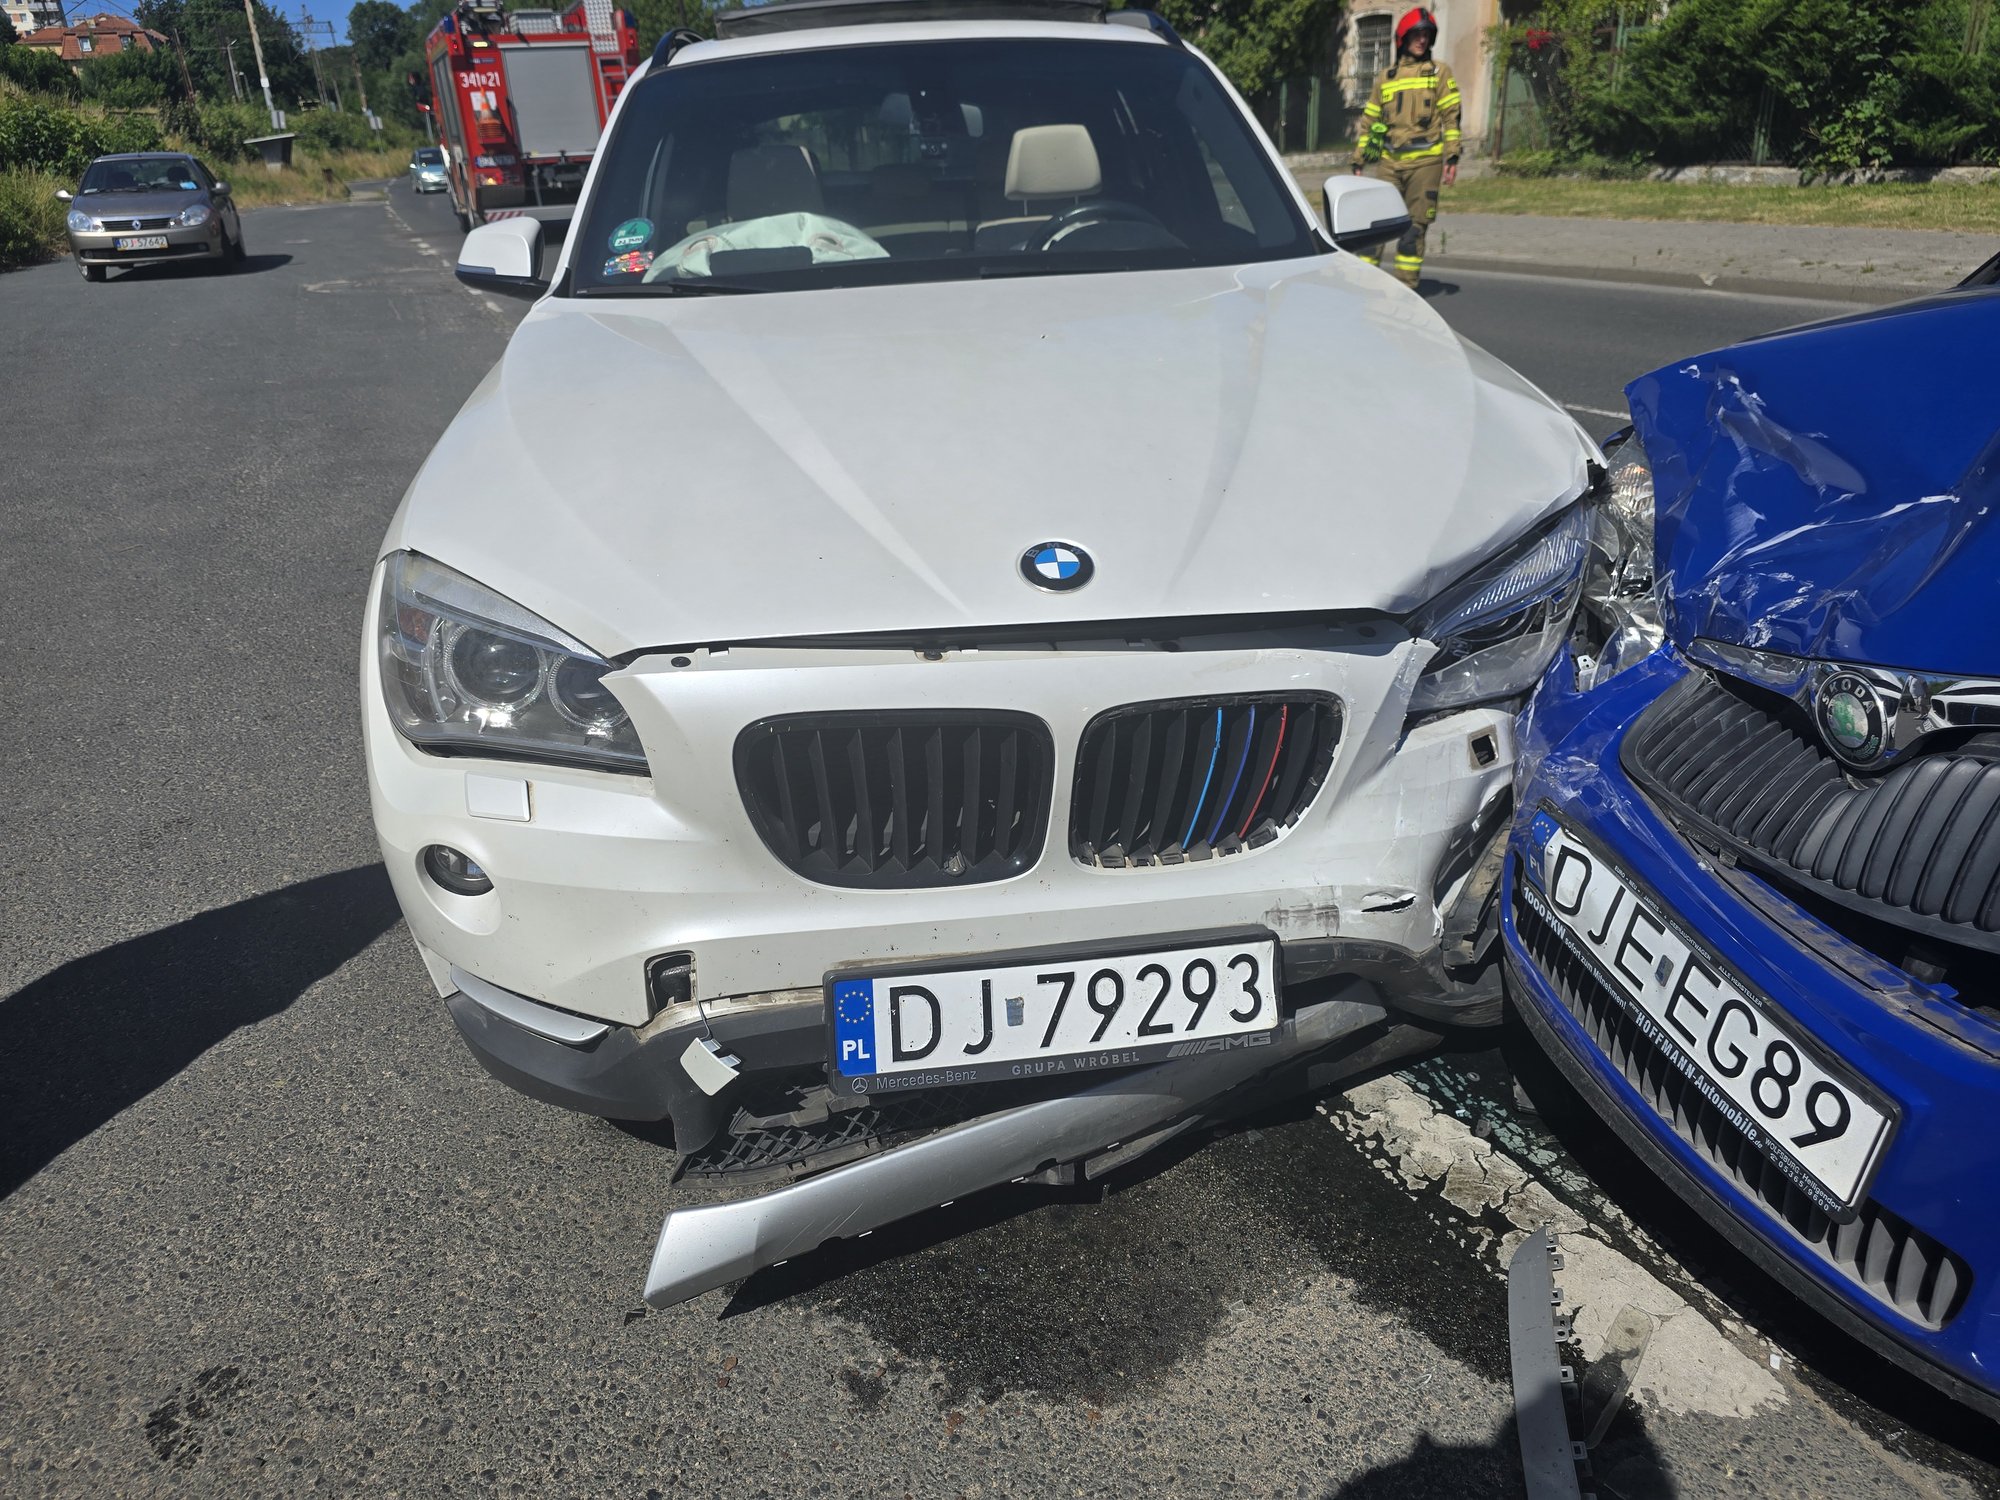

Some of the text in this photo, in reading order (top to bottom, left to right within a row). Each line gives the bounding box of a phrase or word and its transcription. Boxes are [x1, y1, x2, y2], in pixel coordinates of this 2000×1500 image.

[1025, 542, 1085, 559] BMW
[1529, 854, 1545, 881] PL
[1523, 885, 1628, 1010] 1000 PKW sofort zum Mitnehmen!
[889, 950, 1263, 1063] DJ 79293
[1551, 845, 1853, 1150] DJE EG89
[841, 1037, 871, 1062] PL
[1200, 1030, 1273, 1052] AMG
[1010, 1049, 1141, 1077] GRUPA WRÓBEL
[875, 1068, 978, 1091] Mercedes-Benz
[1764, 1136, 1800, 1174] WOLFSBURG
